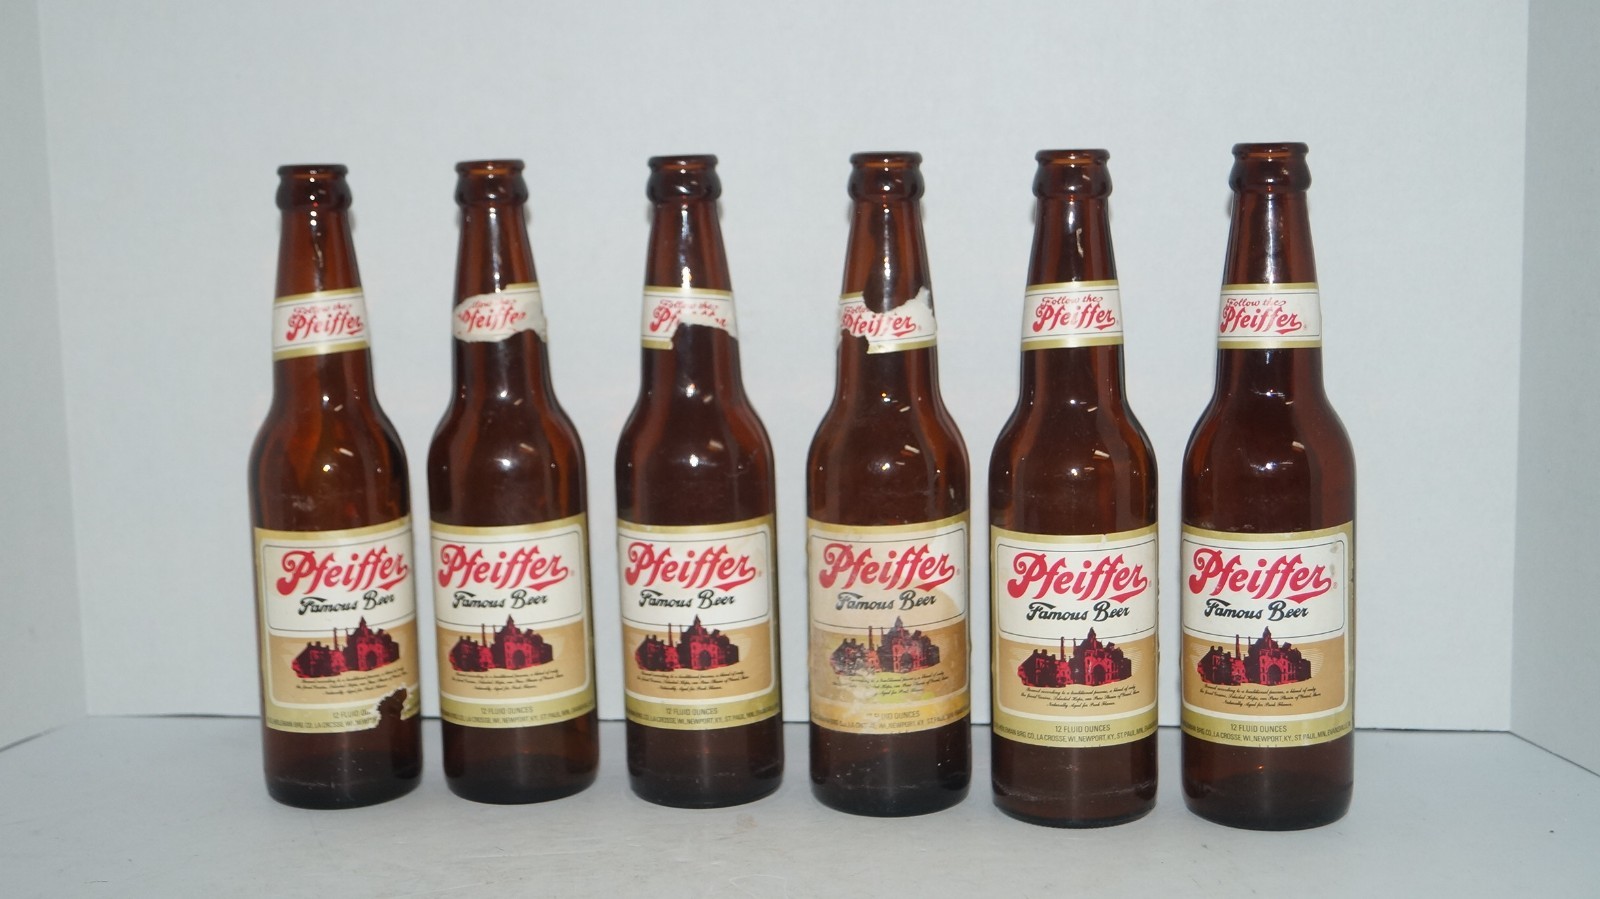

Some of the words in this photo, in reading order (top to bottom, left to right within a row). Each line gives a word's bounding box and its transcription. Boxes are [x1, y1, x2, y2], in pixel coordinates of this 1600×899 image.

[1082, 294, 1103, 303] the
[1226, 298, 1260, 307] Follow
[286, 311, 365, 342] Pfeiffer
[1032, 303, 1116, 333] Pfeiffer
[1220, 306, 1303, 335] Pfeiffer
[276, 545, 409, 596] Pfeiffer
[438, 543, 569, 592] Pfeiffer
[625, 542, 757, 592] Pfeiffer
[819, 543, 956, 593] Pfeiffer
[1007, 552, 1148, 604] Pfeiffer
[1189, 548, 1333, 604] Pfeiffer
[298, 597, 359, 615] Famous
[362, 590, 396, 611] Beer
[452, 590, 506, 608] Famous
[510, 588, 548, 609] Beer
[639, 589, 694, 608] Famous
[697, 589, 735, 609] Beer
[835, 591, 896, 611] Famous
[899, 589, 937, 611] Beer
[1204, 598, 1264, 619] Famous
[1267, 600, 1309, 622] Beer
[1026, 601, 1090, 621] Famous
[1093, 600, 1130, 622] Beer
[666, 707, 672, 715] 12
[673, 707, 690, 715] FLUID
[692, 707, 718, 715] OUNCES
[1055, 725, 1063, 733] 12
[1064, 725, 1083, 733] FLUID
[1084, 724, 1111, 733] OUNCES
[1230, 723, 1238, 731] 12
[1238, 724, 1258, 733] FLUID
[1259, 725, 1288, 733] OUNCES
